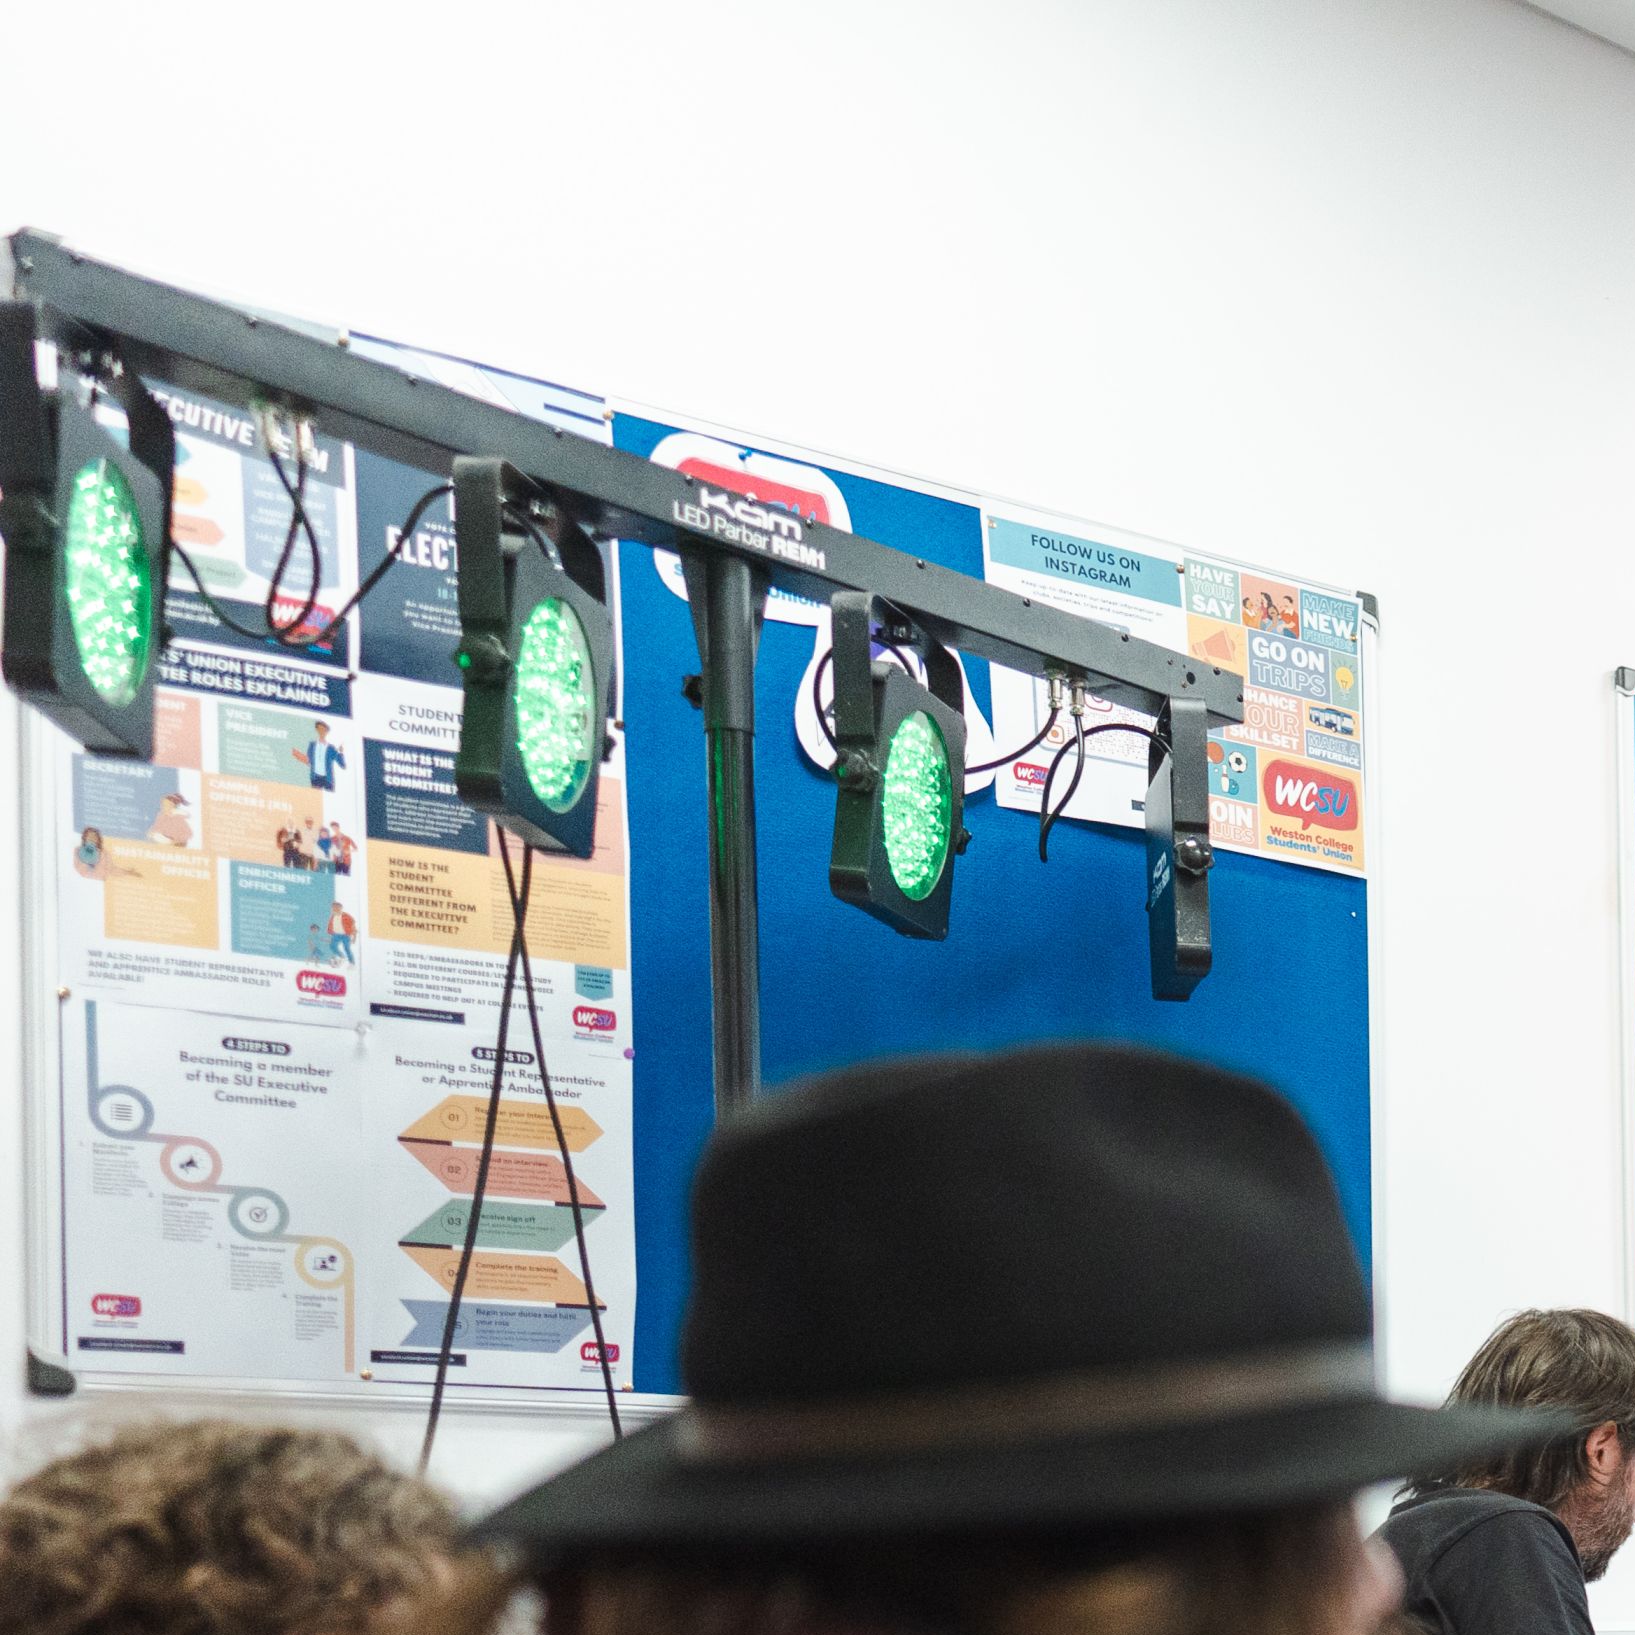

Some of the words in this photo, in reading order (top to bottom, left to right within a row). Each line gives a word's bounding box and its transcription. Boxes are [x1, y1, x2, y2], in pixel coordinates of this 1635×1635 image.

[673, 498, 711, 531] LED
[713, 514, 770, 550] Parbar
[1031, 533, 1093, 560] FOLLOW
[1096, 550, 1116, 566] US
[1119, 556, 1141, 573] ON
[1044, 556, 1132, 589] INSTAGRAM
[1189, 562, 1234, 587] HAVE
[1190, 577, 1235, 602] YOUR
[1191, 593, 1235, 620] SAY
[1303, 592, 1355, 622] MAKE
[1303, 609, 1355, 640] NEW
[1252, 636, 1287, 663] GO
[1291, 647, 1326, 673] ON
[187, 650, 241, 673] UNION
[245, 659, 327, 690] EXECUTIVE
[1253, 660, 1327, 698] TRIPS
[192, 670, 243, 692] ROLES
[247, 679, 331, 707] EXPLAINED
[1230, 724, 1300, 751] SKILLSET
[1307, 733, 1349, 755] MAKE
[1349, 744, 1361, 757] A
[383, 748, 419, 764] WHAT
[433, 756, 455, 770] THE
[1308, 747, 1361, 767] DIFFERENCE
[383, 762, 433, 779] STUDENT
[1275, 774, 1349, 817] WCSU
[1266, 835, 1321, 854] Students'
[1323, 843, 1353, 862] Union
[1270, 825, 1313, 843] Weston
[1315, 833, 1354, 853] College
[238, 865, 312, 885] ENRICHMENT
[389, 857, 415, 869] HOW
[417, 861, 429, 871] IS
[431, 863, 450, 873] THE
[238, 879, 286, 894] OFFICER
[389, 869, 434, 883] STUDENT
[389, 882, 453, 898] COMMITTEE
[389, 894, 444, 909] DIFFERENT
[446, 901, 477, 913] FROM
[389, 906, 409, 917] THE
[411, 908, 469, 924] EXECUTIVE
[390, 918, 460, 935] COMMITTEE?
[164, 957, 206, 969] STUDENT
[208, 962, 285, 979] REPRESENTATIVE
[174, 969, 239, 983] AMBASSADOR
[242, 977, 271, 988] ROLES
[393, 970, 430, 981] REQUIRED
[442, 974, 489, 987] PARTICIPATE
[393, 990, 430, 1000] REQUIRED
[425, 983, 462, 994] MEETINGS
[237, 1040, 269, 1052] STEPS
[272, 1043, 287, 1054] TO
[179, 1050, 253, 1072] Becoming
[256, 1062, 267, 1071] a
[271, 1063, 333, 1078] member
[517, 1053, 530, 1063] TO
[395, 1056, 455, 1073] Becoming
[458, 1064, 467, 1072] a
[519, 1069, 606, 1088] Repesentative
[422, 1075, 435, 1084] or
[186, 1071, 201, 1081] of
[205, 1071, 229, 1085] the
[233, 1074, 252, 1087] SU
[258, 1076, 328, 1095] Executive
[214, 1089, 297, 1108] Committee
[447, 1216, 462, 1226] 03
[475, 1262, 513, 1273] Complete
[529, 1265, 559, 1274] training
[475, 1308, 499, 1318] Begin
[499, 1310, 517, 1318] your
[518, 1311, 542, 1319] duties
[475, 1319, 493, 1328] your
